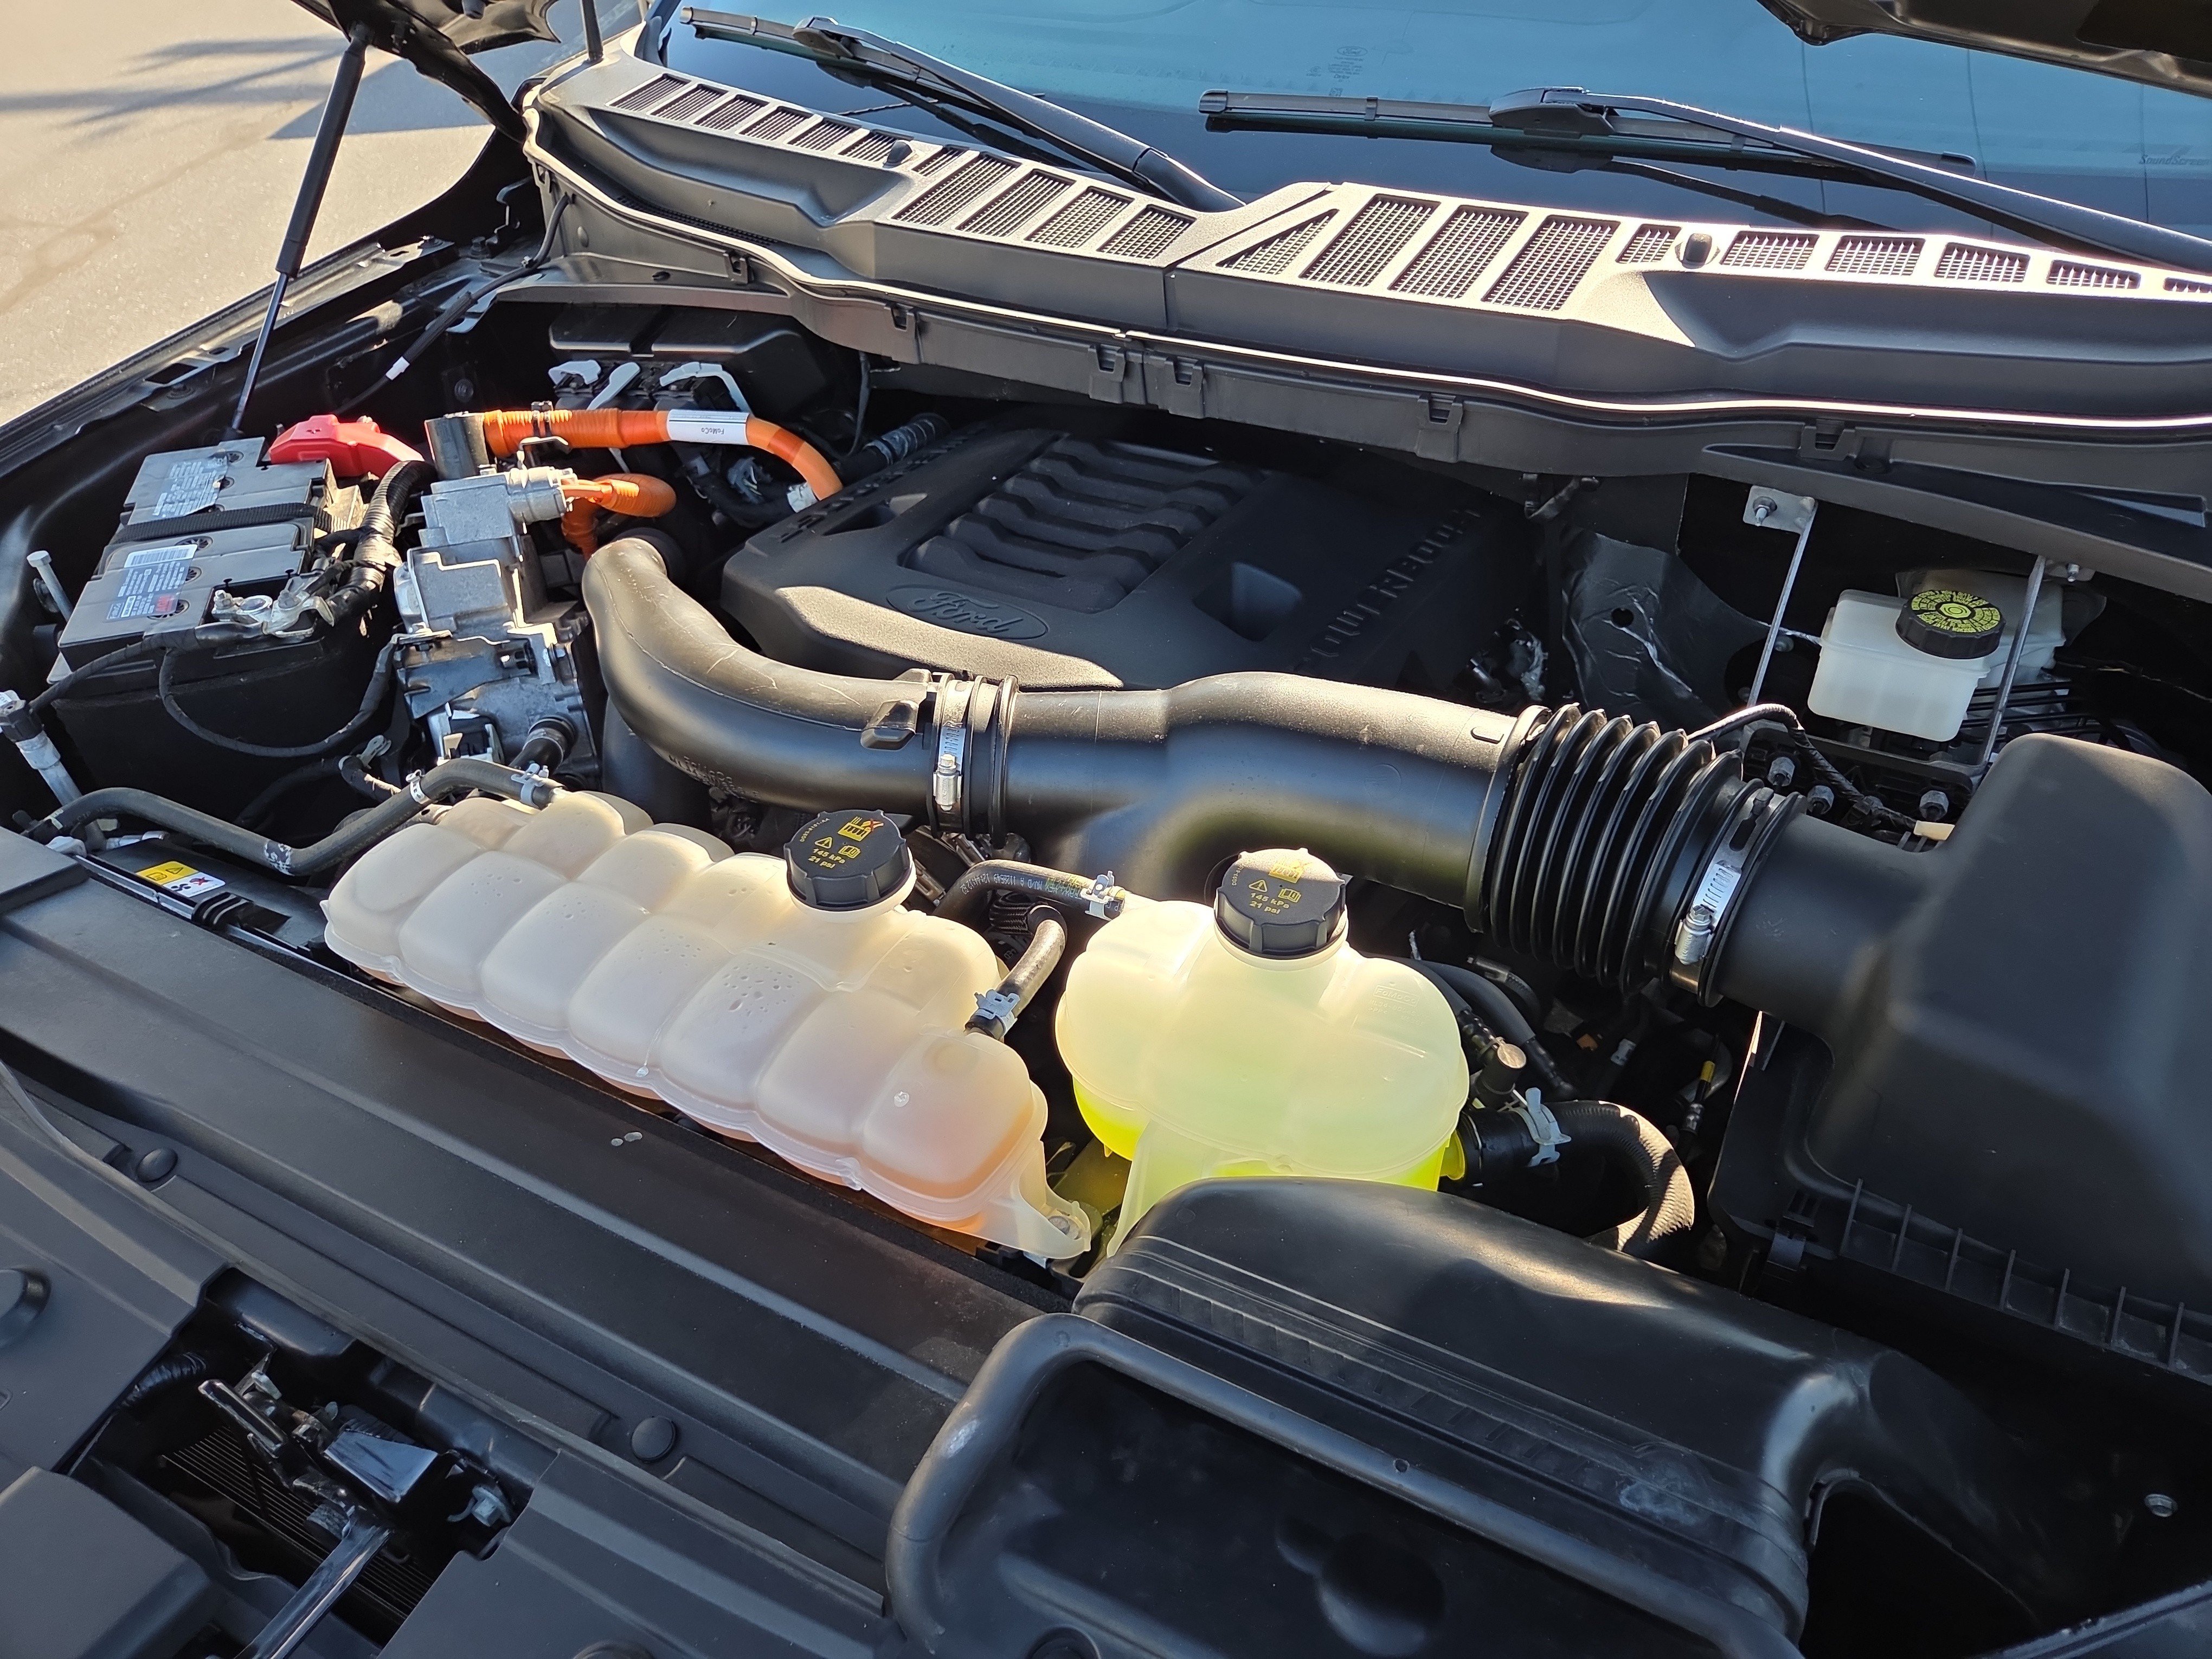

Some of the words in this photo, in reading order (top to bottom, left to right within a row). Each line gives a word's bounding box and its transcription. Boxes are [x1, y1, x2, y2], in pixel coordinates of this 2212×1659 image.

[701, 427, 724, 435] FoMoCo
[907, 591, 1024, 634] Ford
[813, 848, 830, 857] 145
[828, 854, 846, 864] kPa
[1249, 901, 1263, 909] 21
[1264, 906, 1281, 915] psi
[1250, 892, 1269, 902] 145
[1270, 898, 1290, 909] kPa
[1375, 988, 1417, 1004] FoMoCo
